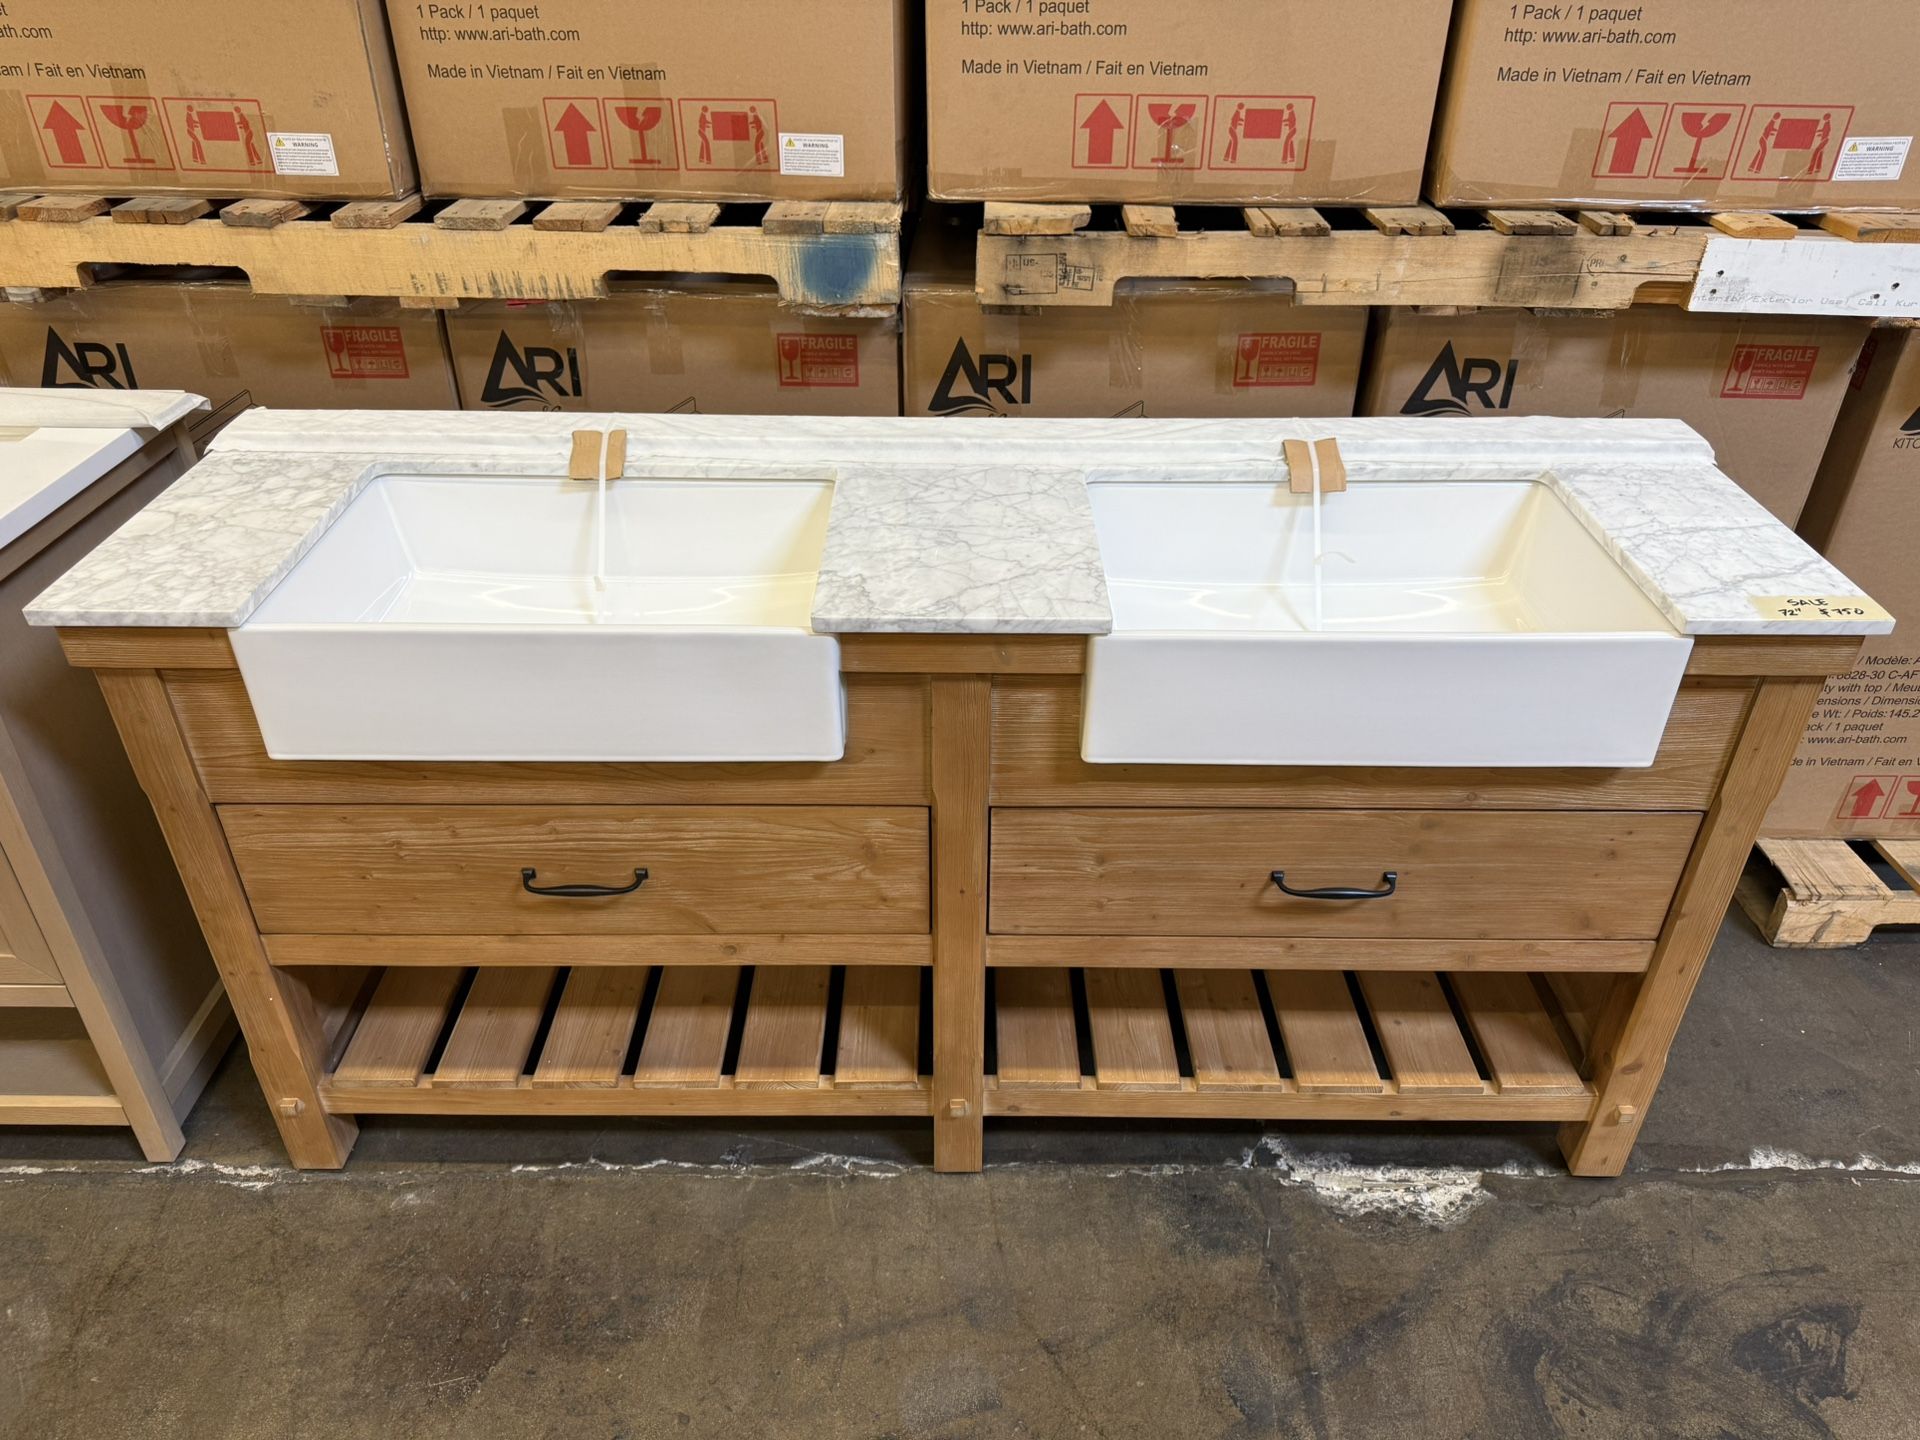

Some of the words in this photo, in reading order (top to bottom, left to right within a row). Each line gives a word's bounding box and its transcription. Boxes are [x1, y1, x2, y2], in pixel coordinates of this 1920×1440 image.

[416, 5, 424, 19] 1
[429, 4, 465, 19] Pack
[477, 5, 485, 19] 1
[490, 5, 540, 22] paquet
[962, 0, 969, 13] 1
[975, 0, 1012, 13] Pack
[1026, 0, 1033, 13] 1
[1039, 0, 1090, 17] paquet
[1510, 5, 1518, 19] 1
[1523, 4, 1561, 20] Pack
[1576, 5, 1584, 20] 1
[1588, 6, 1642, 24] paquet
[420, 26, 450, 44] http:
[454, 26, 580, 41] www.ari-bath.com
[961, 21, 993, 38] http:
[997, 21, 1127, 36] www.ari-bath.com
[1504, 28, 1537, 46] http:
[1542, 28, 1676, 44] www.ari-bath.com
[35, 62, 62, 77] Fait
[66, 66, 84, 78] en
[86, 63, 146, 79] Vietnam
[427, 64, 467, 79] Made
[470, 64, 483, 79] in
[486, 64, 544, 79] Vietnam
[556, 65, 583, 80] Fait
[587, 68, 605, 80] en
[608, 66, 666, 80] Vietnam
[961, 59, 1002, 74] Made
[1006, 60, 1019, 74] in
[1023, 60, 1082, 75] Vietnam
[1096, 60, 1122, 75] Fait
[1127, 64, 1144, 75] en
[1150, 61, 1208, 76] Vietnam
[1497, 67, 1539, 82] Made
[1543, 67, 1557, 82] in
[1562, 67, 1622, 83] Vietnam
[1625, 68, 1633, 84] /
[1635, 69, 1664, 84] Fait
[1667, 72, 1685, 84] en
[1691, 70, 1751, 86] Vietnam
[344, 329, 399, 342] FRAGILE
[801, 337, 854, 349] FRAGILE
[1261, 336, 1318, 348] FRAGILE
[41, 325, 138, 389] ARI
[1756, 348, 1815, 362] FRAGILE
[480, 329, 582, 403] ARI
[928, 336, 1031, 411] ARI
[1400, 340, 1519, 415] ARI
[1786, 598, 1829, 606] SALE
[1865, 655, 1912, 665] Modèle:
[1837, 683, 1861, 692] with
[1864, 684, 1882, 694] top
[1816, 696, 1861, 706] ensions
[1843, 722, 1884, 733] paquet
[1807, 735, 1907, 744] www.ari-bath.com
[1805, 757, 1816, 766] in
[1820, 757, 1865, 766] Vietnam
[1874, 757, 1896, 766] Fait
